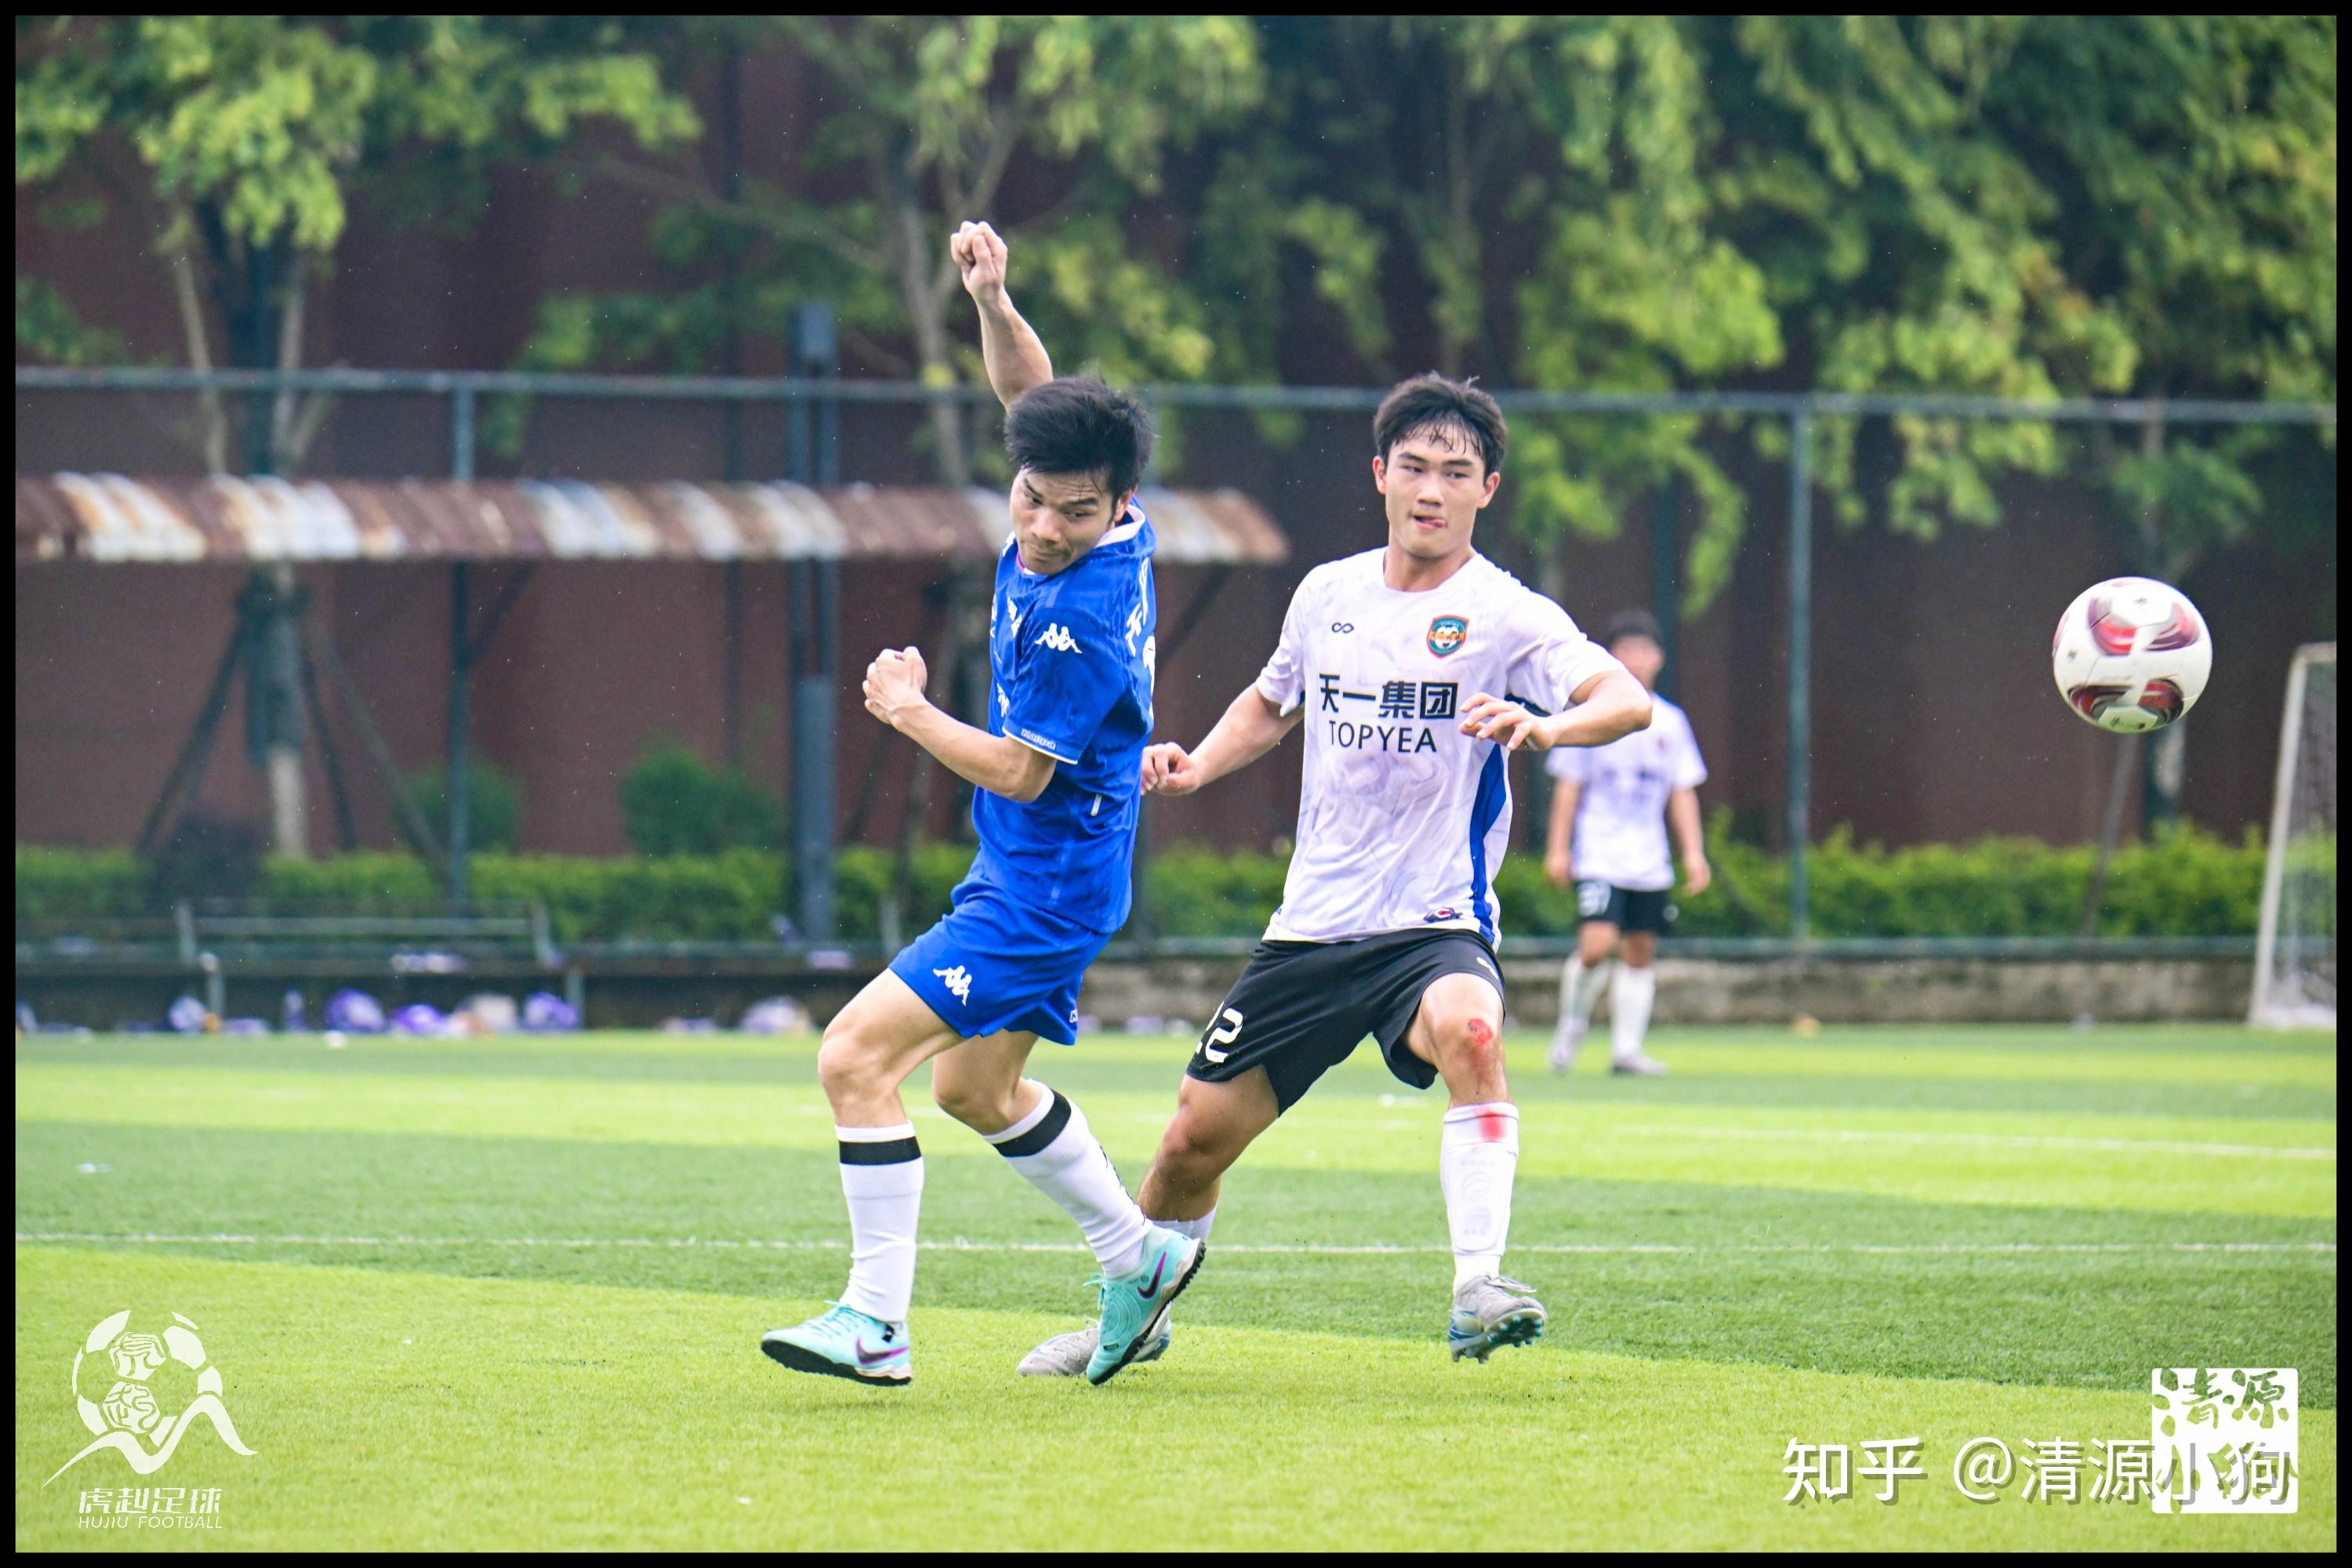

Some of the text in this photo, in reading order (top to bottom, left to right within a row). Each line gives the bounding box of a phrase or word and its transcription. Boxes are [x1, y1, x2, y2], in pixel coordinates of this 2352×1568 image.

[1319, 673, 1459, 720] 天一集团
[1329, 720, 1438, 753] TOPYEA
[1195, 1000, 1243, 1063] 2
